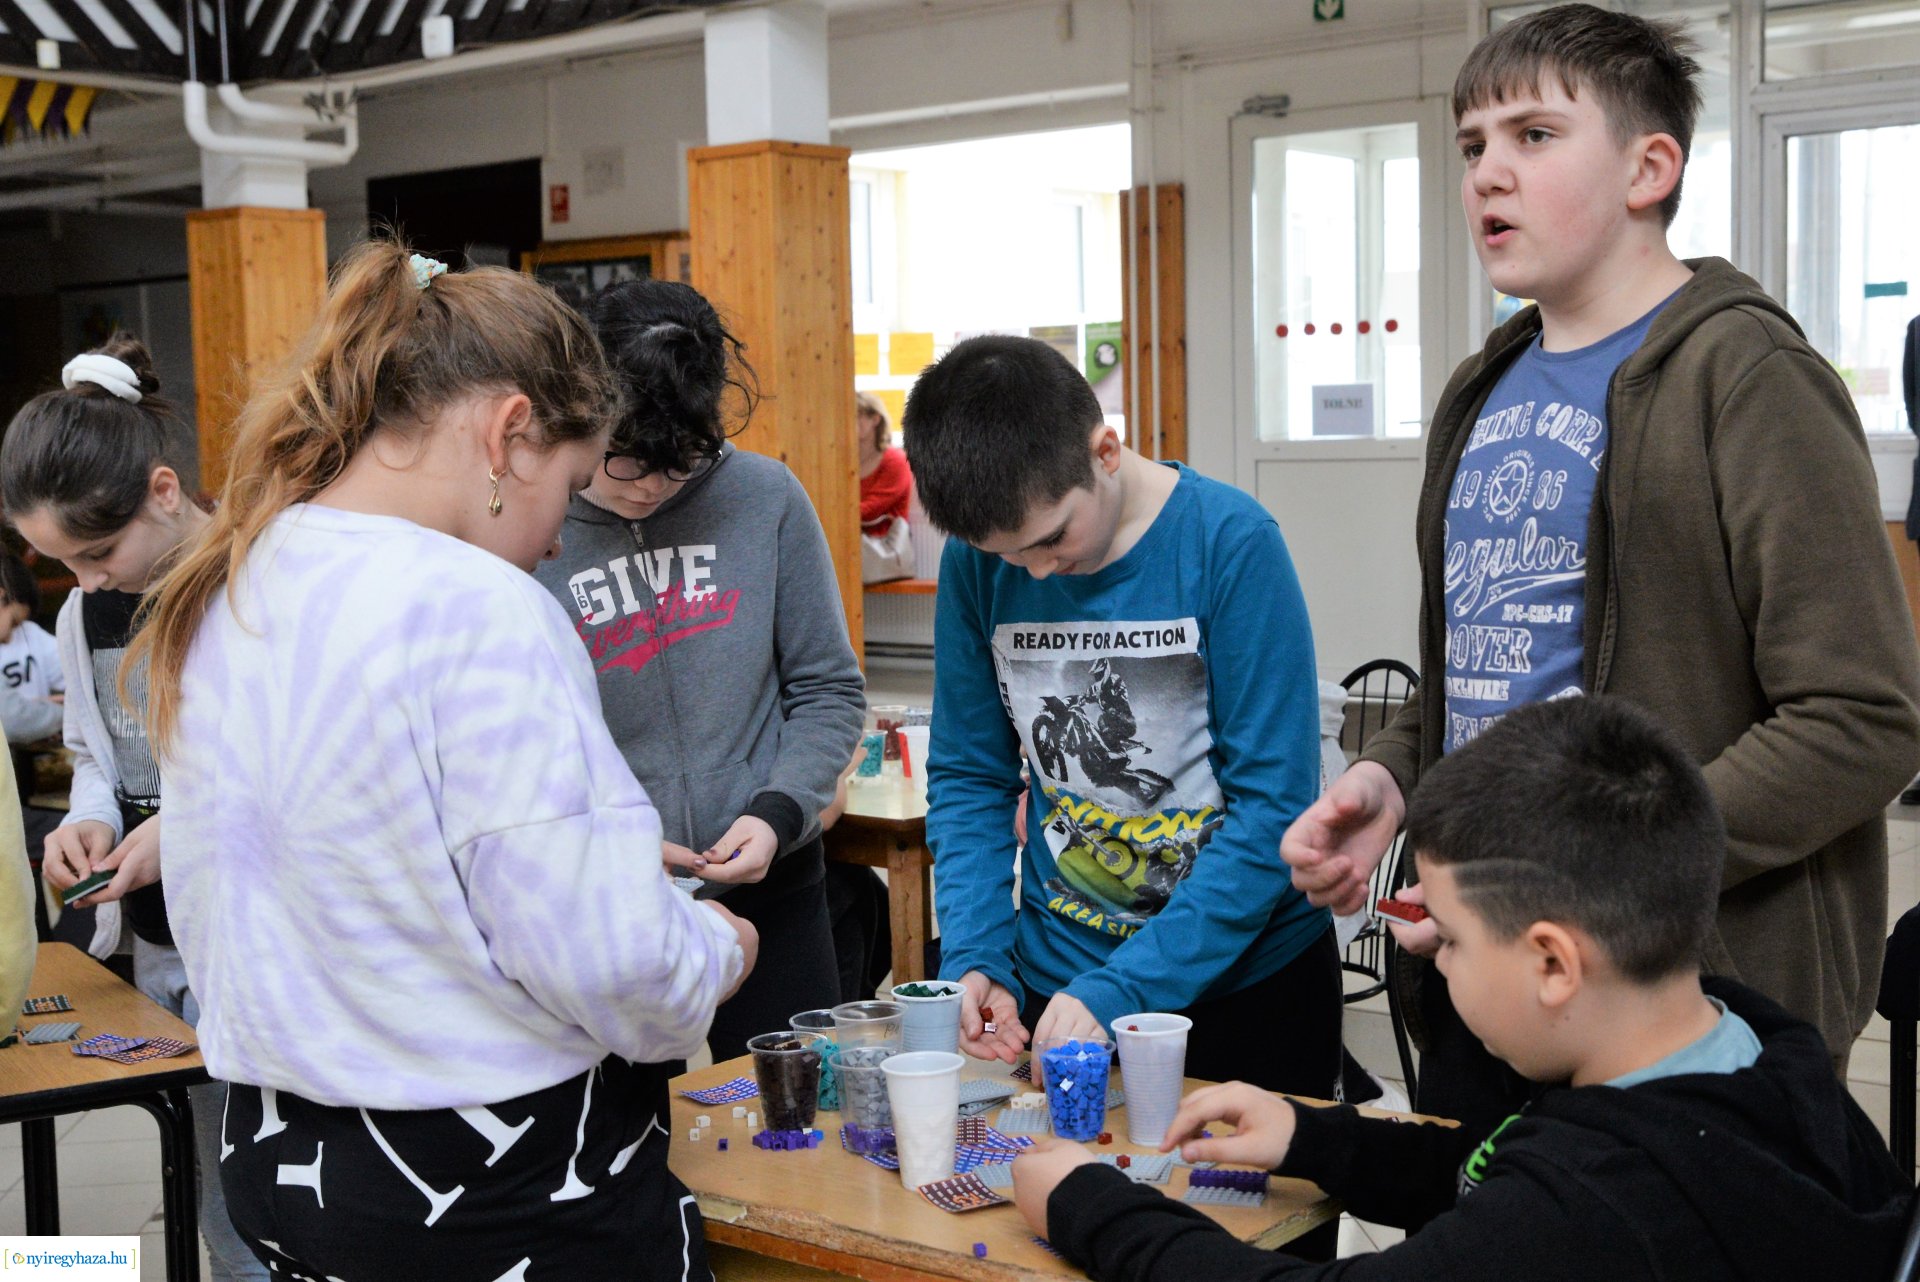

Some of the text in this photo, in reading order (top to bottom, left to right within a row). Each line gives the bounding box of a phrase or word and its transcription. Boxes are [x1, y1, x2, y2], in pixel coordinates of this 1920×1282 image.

[568, 545, 717, 626] GIVE
[1013, 627, 1187, 650] READY FOR ACTION
[1445, 622, 1533, 674] OVER
[1047, 897, 1105, 930] AREA
